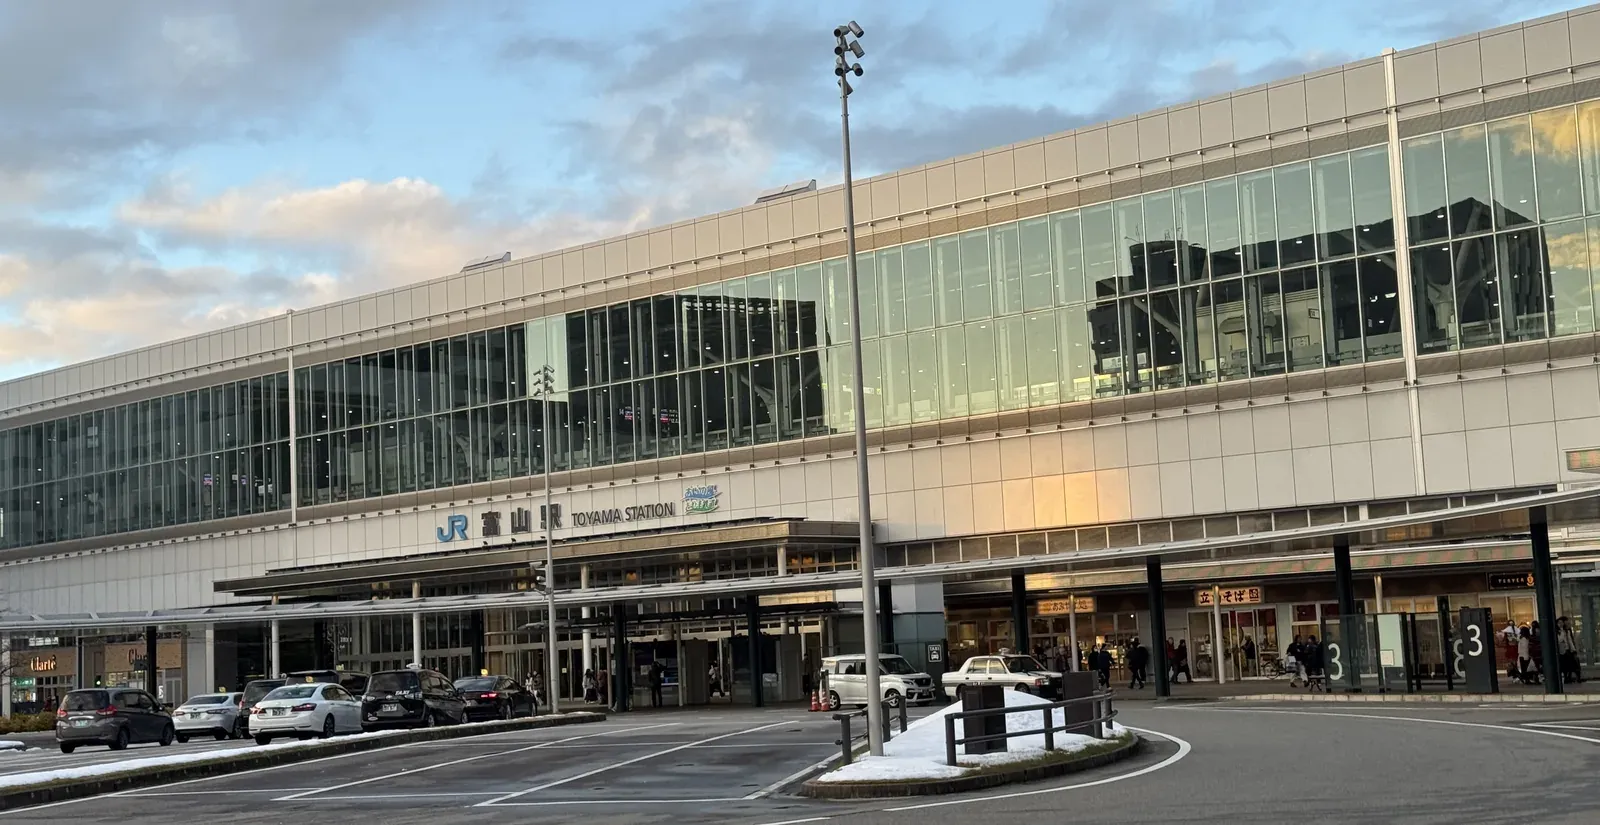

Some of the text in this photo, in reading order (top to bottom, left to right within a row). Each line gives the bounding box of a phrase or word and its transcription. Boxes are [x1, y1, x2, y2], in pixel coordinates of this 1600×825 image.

[437, 502, 675, 542] JR 富山駅 TOYAMA STATION
[1200, 589, 1245, 604] 立そば
[1466, 624, 1483, 657] 3
[31, 655, 56, 671] Clarté
[1327, 643, 1343, 680] 3
